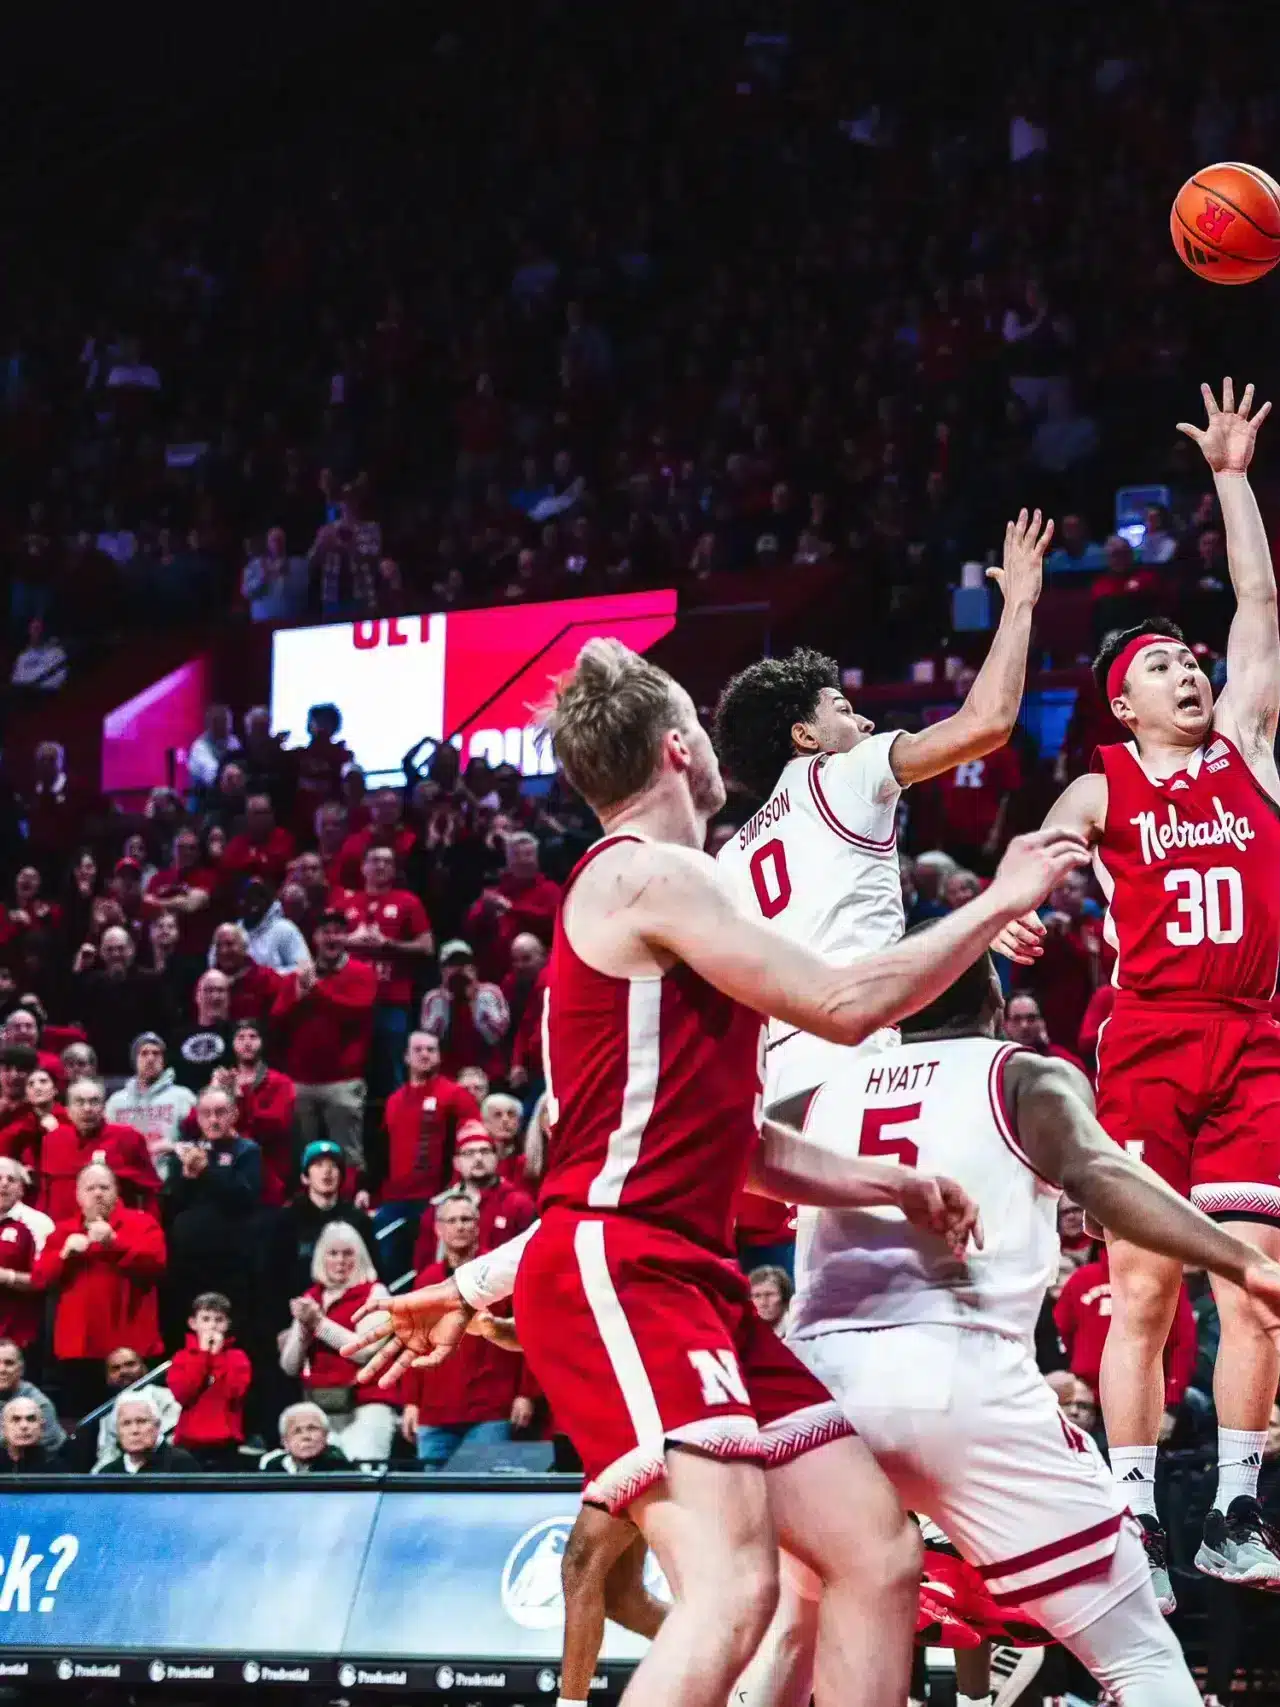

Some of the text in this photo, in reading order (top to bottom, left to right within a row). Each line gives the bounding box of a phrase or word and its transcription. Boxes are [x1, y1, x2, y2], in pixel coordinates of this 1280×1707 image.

[739, 788, 791, 850] SIMPSON
[1129, 796, 1255, 865] Nebraska
[750, 838, 792, 920] 0
[1163, 867, 1244, 946] 30
[865, 1061, 940, 1094] HYATT
[858, 1101, 922, 1169] 5
[687, 1348, 751, 1407] N
[0, 1533, 80, 1613] k?
[74, 1663, 121, 1678] Prudential
[166, 1665, 214, 1680] Prudential
[261, 1666, 310, 1682] Prudential
[357, 1670, 407, 1686] Prudential
[455, 1673, 506, 1688] Prudential
